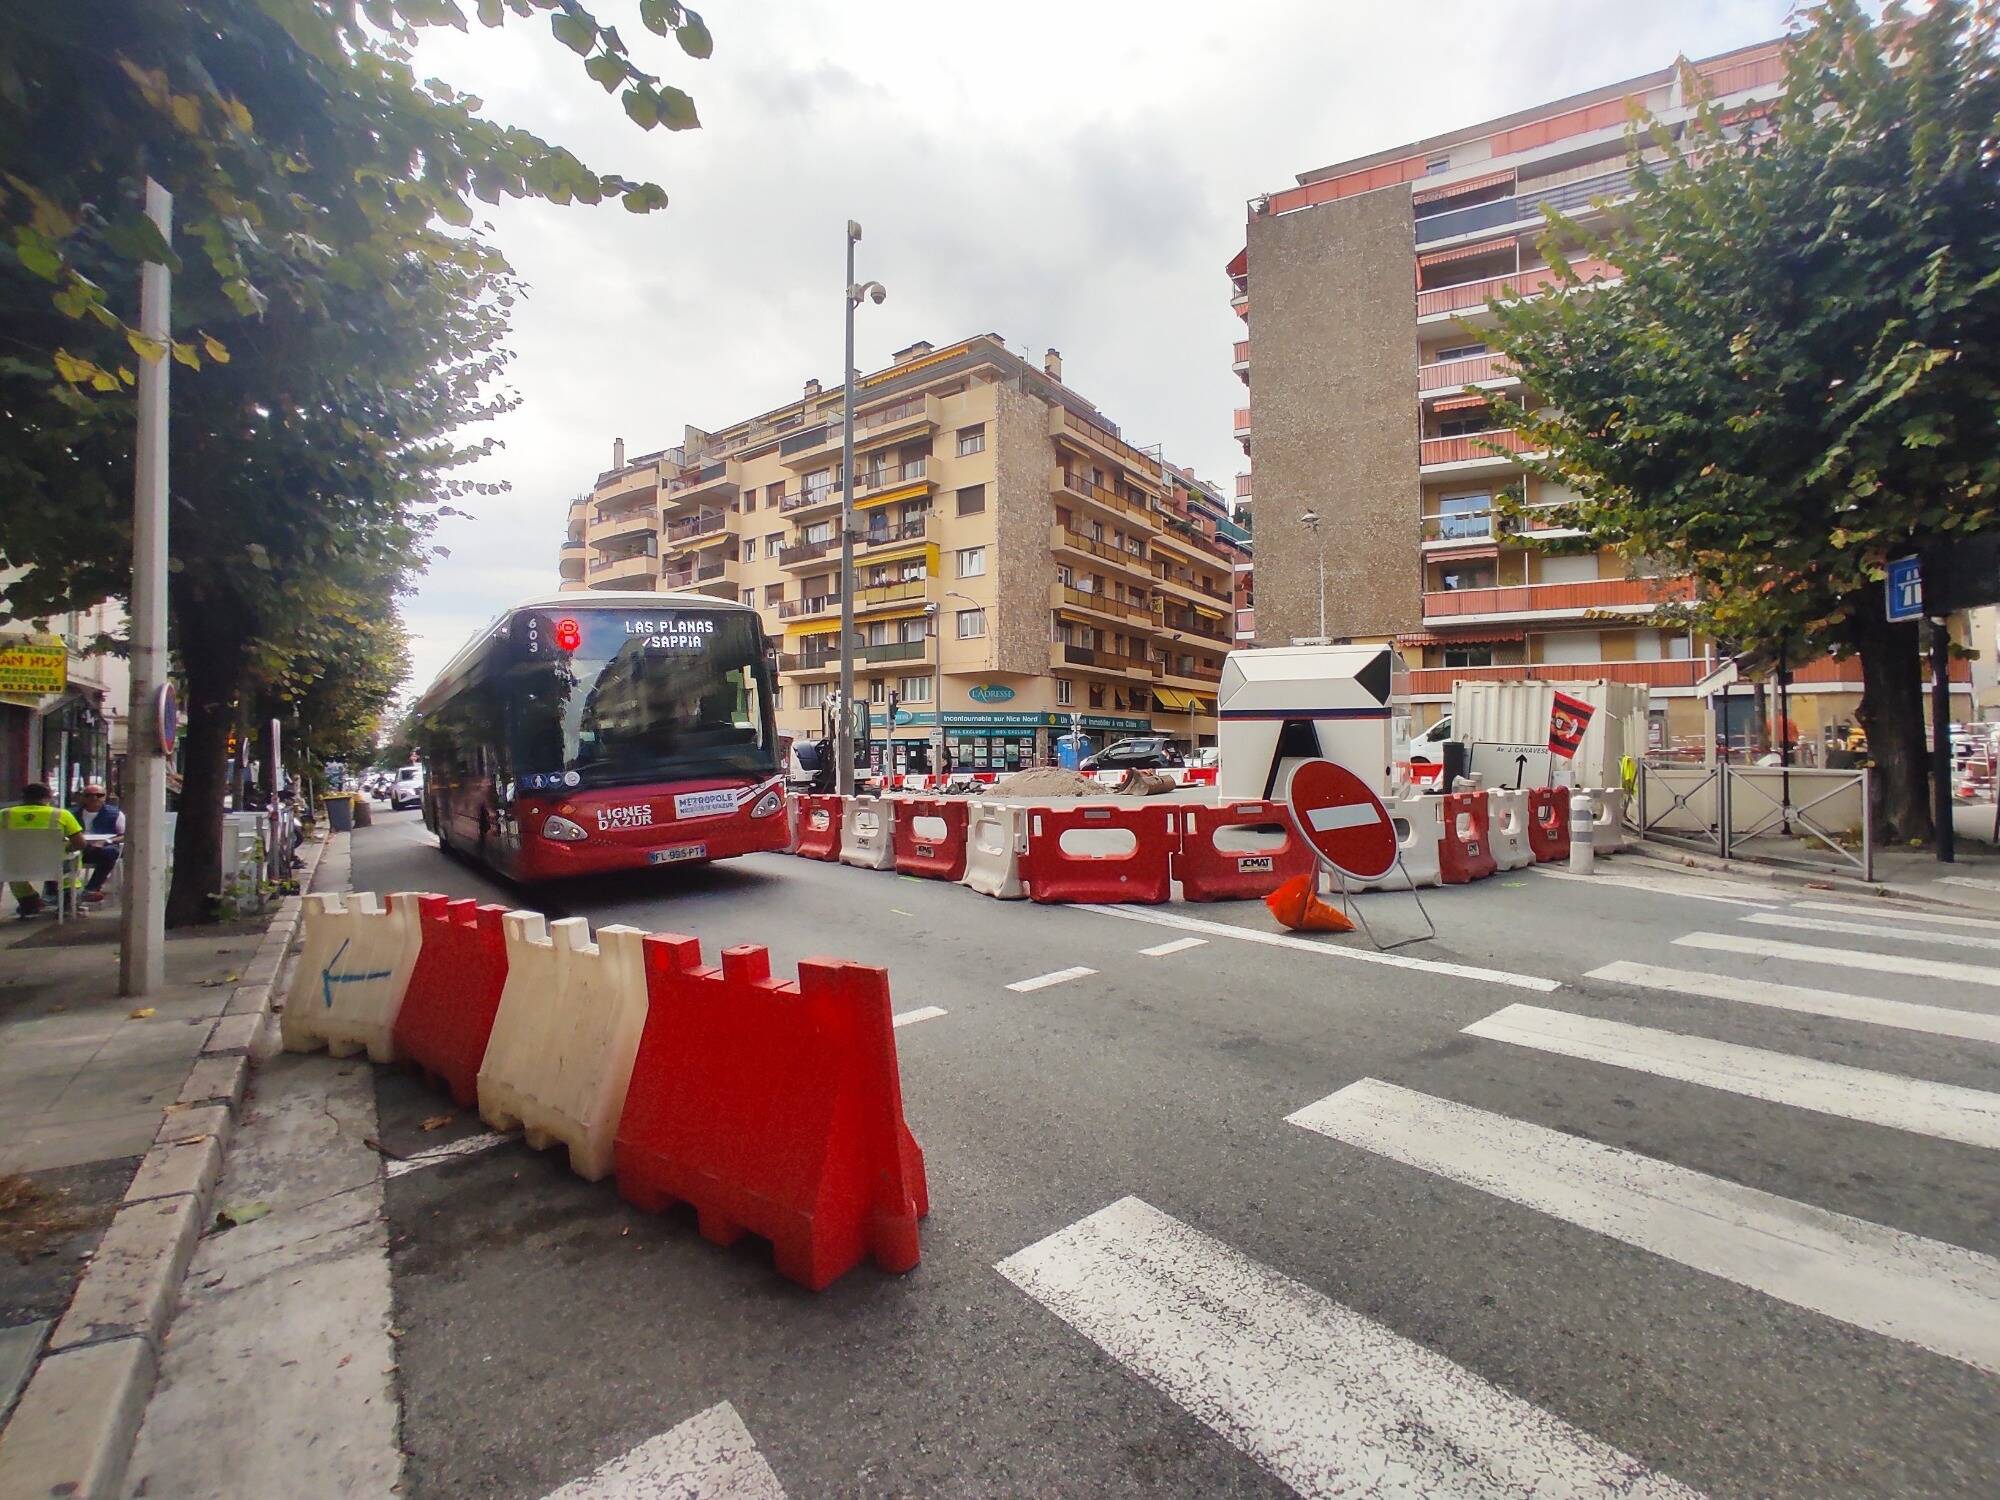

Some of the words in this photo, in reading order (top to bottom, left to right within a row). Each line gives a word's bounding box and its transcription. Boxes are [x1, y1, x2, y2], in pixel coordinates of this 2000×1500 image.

[625, 620, 653, 634] LAS
[660, 620, 713, 634] PLANAS
[943, 715, 992, 723] Incontournable
[1006, 715, 1021, 723] Nice
[1022, 715, 1039, 723] Nord
[1060, 716, 1068, 725] Un
[597, 804, 652, 821] LIGNES
[1240, 858, 1270, 868] JCMAT
